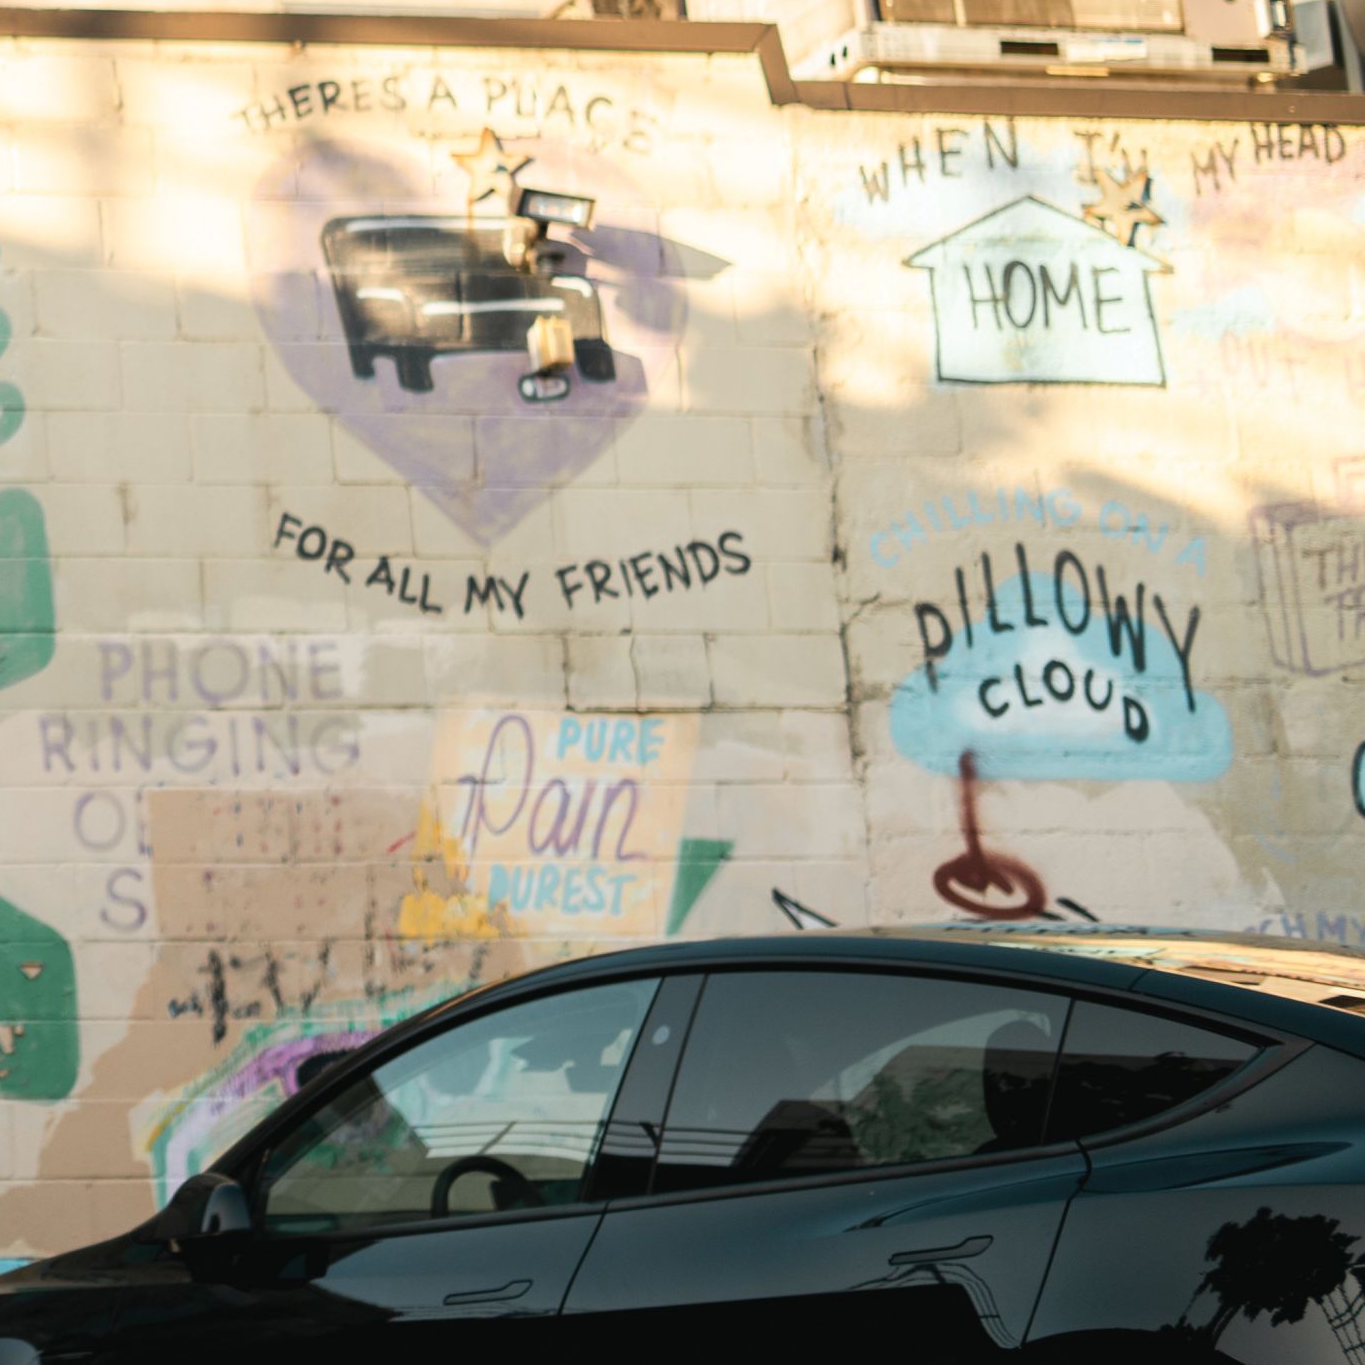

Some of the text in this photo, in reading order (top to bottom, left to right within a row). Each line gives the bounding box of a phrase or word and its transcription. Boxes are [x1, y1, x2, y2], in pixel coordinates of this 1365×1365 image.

[427, 75, 459, 111] A
[858, 117, 1019, 205] WHEN
[1190, 122, 1348, 195] MY HEAD
[962, 258, 1132, 336] HOME
[273, 511, 752, 619] FOR ALL MY FRIENDS
[868, 487, 1209, 578] CHILLING ON A
[913, 542, 1202, 715] PILLOWY
[98, 639, 345, 704] PHONE
[977, 658, 1151, 745] CLOUD
[38, 714, 362, 778] RINGING
[557, 716, 666, 765] PURE
[456, 713, 650, 862] Pain
[487, 863, 640, 917] PUREST
